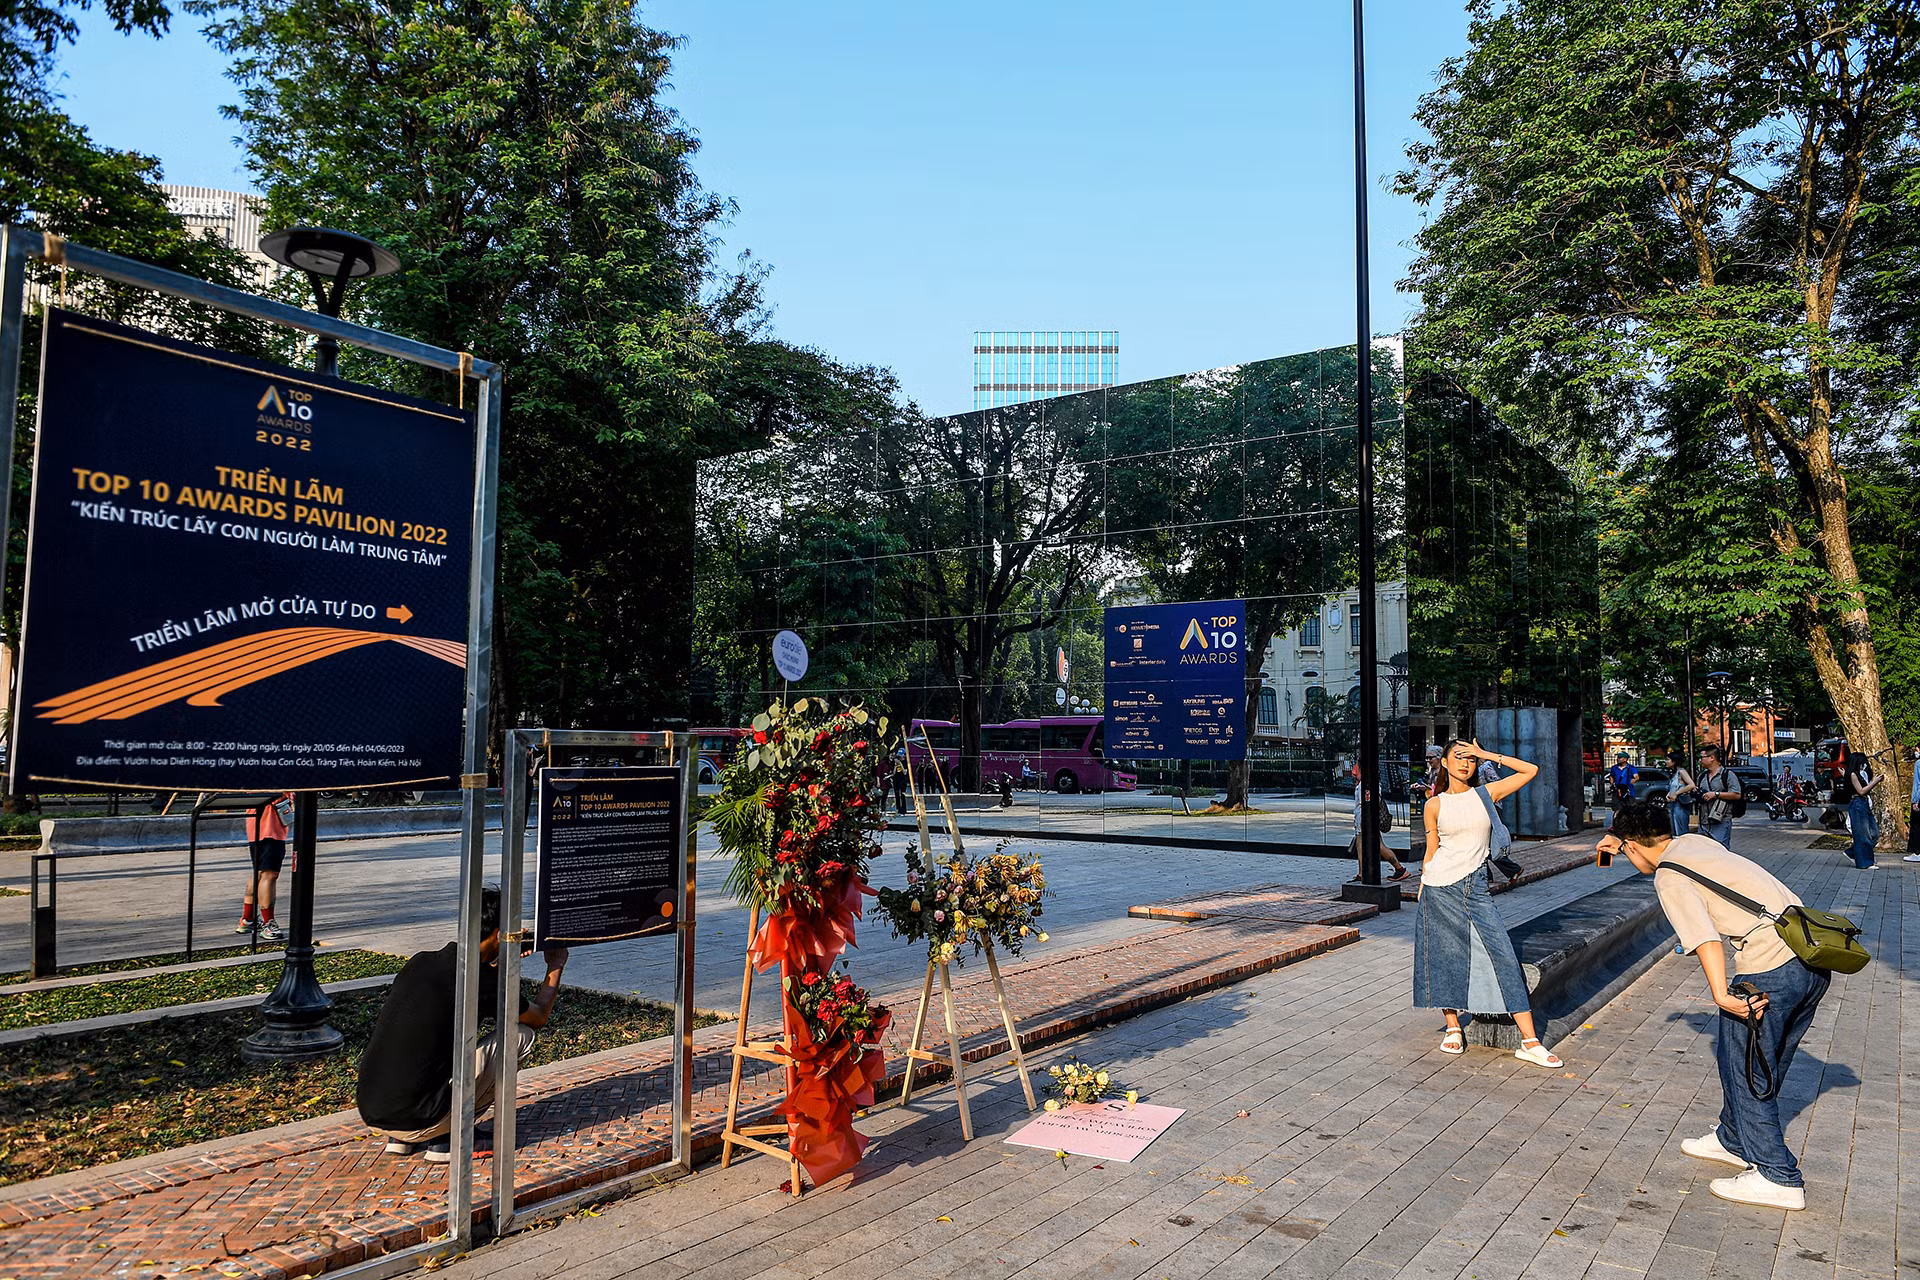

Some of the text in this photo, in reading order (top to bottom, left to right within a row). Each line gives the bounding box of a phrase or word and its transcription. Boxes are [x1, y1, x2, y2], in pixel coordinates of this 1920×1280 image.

[288, 389, 313, 402] TOP
[288, 402, 313, 420] 10
[257, 414, 312, 434] AWARDS
[256, 430, 312, 452] 2022
[215, 466, 344, 505] TRIỂN LÃM
[72, 467, 448, 545] TOP 10 AWARDS PAVILION 2022
[130, 509, 179, 530] TRÚC
[184, 515, 217, 535] LẤY
[220, 523, 259, 541] CON
[263, 528, 318, 549] NGƯỜI
[321, 535, 355, 554] LÀM
[358, 542, 408, 562] TRUNG
[130, 594, 377, 652] TRIỂN LÃM MỞ CỬA TỰ DO
[1210, 616, 1237, 628] TOP
[1210, 631, 1238, 649] 10
[1180, 652, 1238, 665] AWARDS
[126, 741, 147, 751] gian
[186, 742, 204, 750] 8:00
[212, 742, 235, 751] 22:00
[313, 743, 335, 752] 20/05
[365, 744, 405, 753] 04/06/2023
[150, 757, 169, 766] hoa
[261, 758, 277, 766] hoa
[278, 758, 295, 766] Con
[398, 759, 408, 767] Hà
[602, 802, 629, 810] AWARDS
[629, 801, 656, 809] PAVILION
[1075, 1125, 1124, 1137] AWARDS
[1124, 1132, 1154, 1141] 2022
